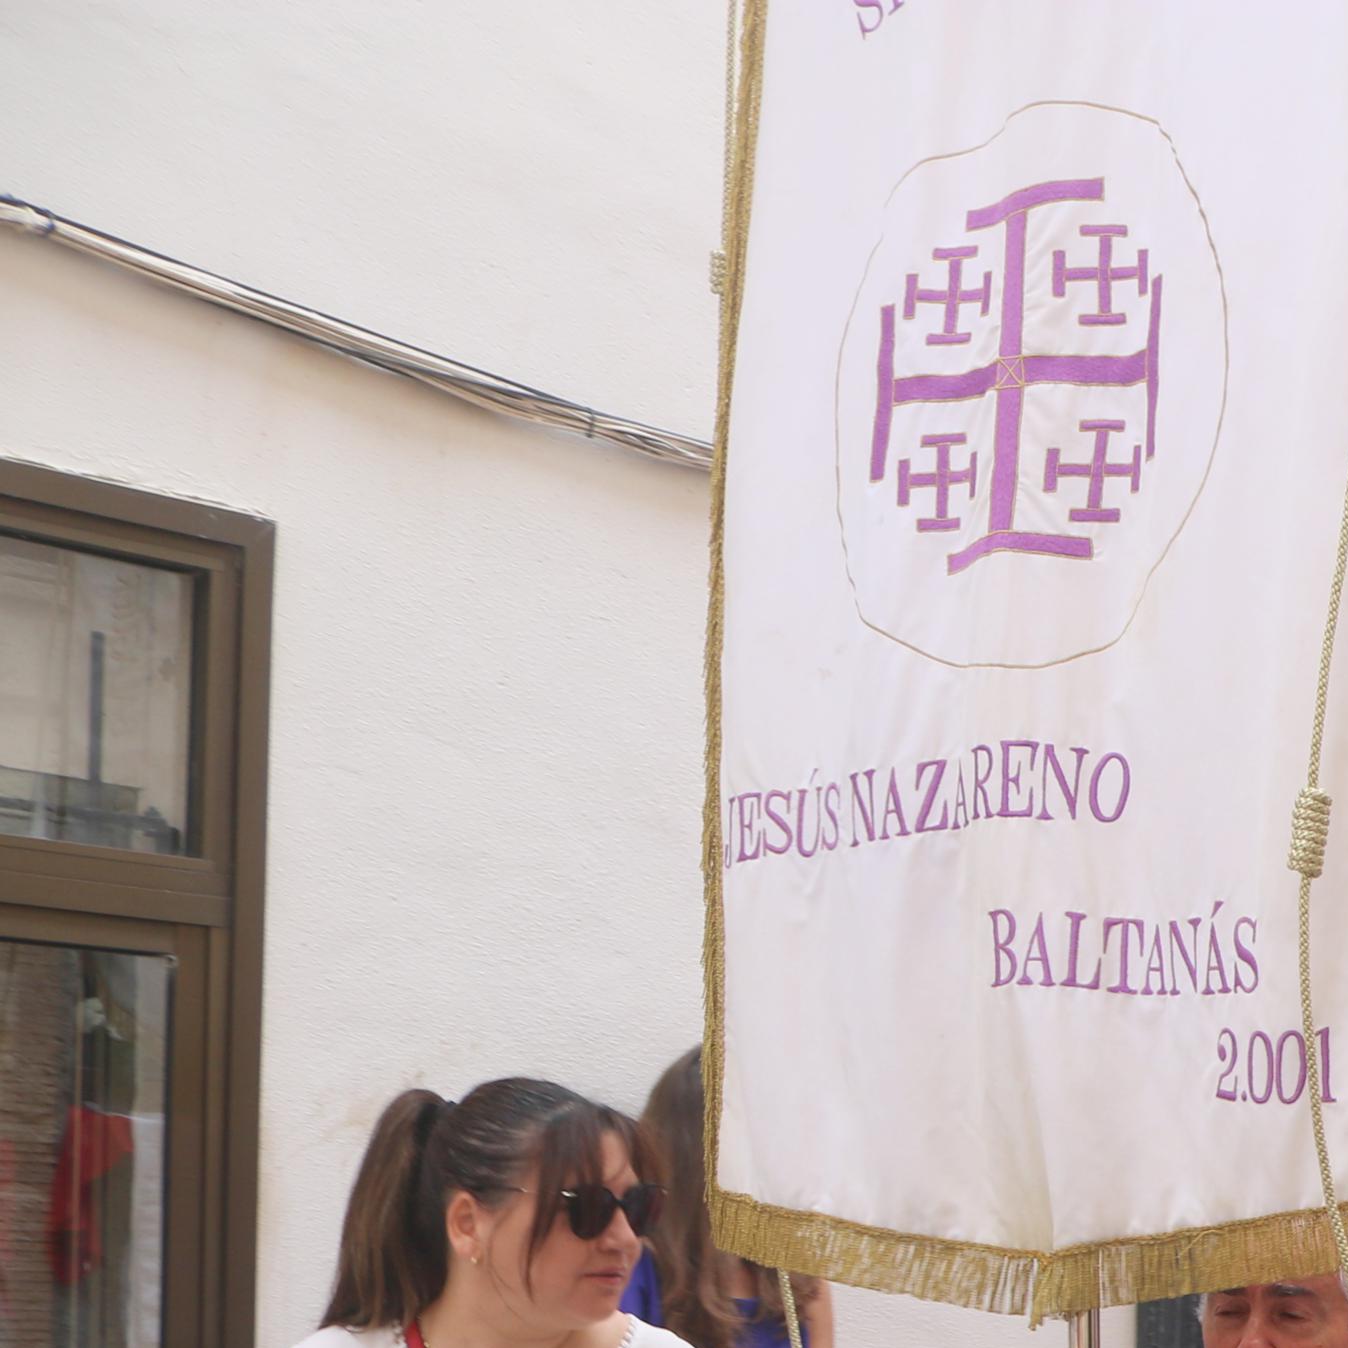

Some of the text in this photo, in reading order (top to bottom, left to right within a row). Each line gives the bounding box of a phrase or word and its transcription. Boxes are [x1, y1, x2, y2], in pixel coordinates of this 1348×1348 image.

[724, 738, 1132, 869] JESÚS NAZARENO
[988, 901, 1261, 996] BALTANÁS
[1215, 1026, 1337, 1105] 2.001
